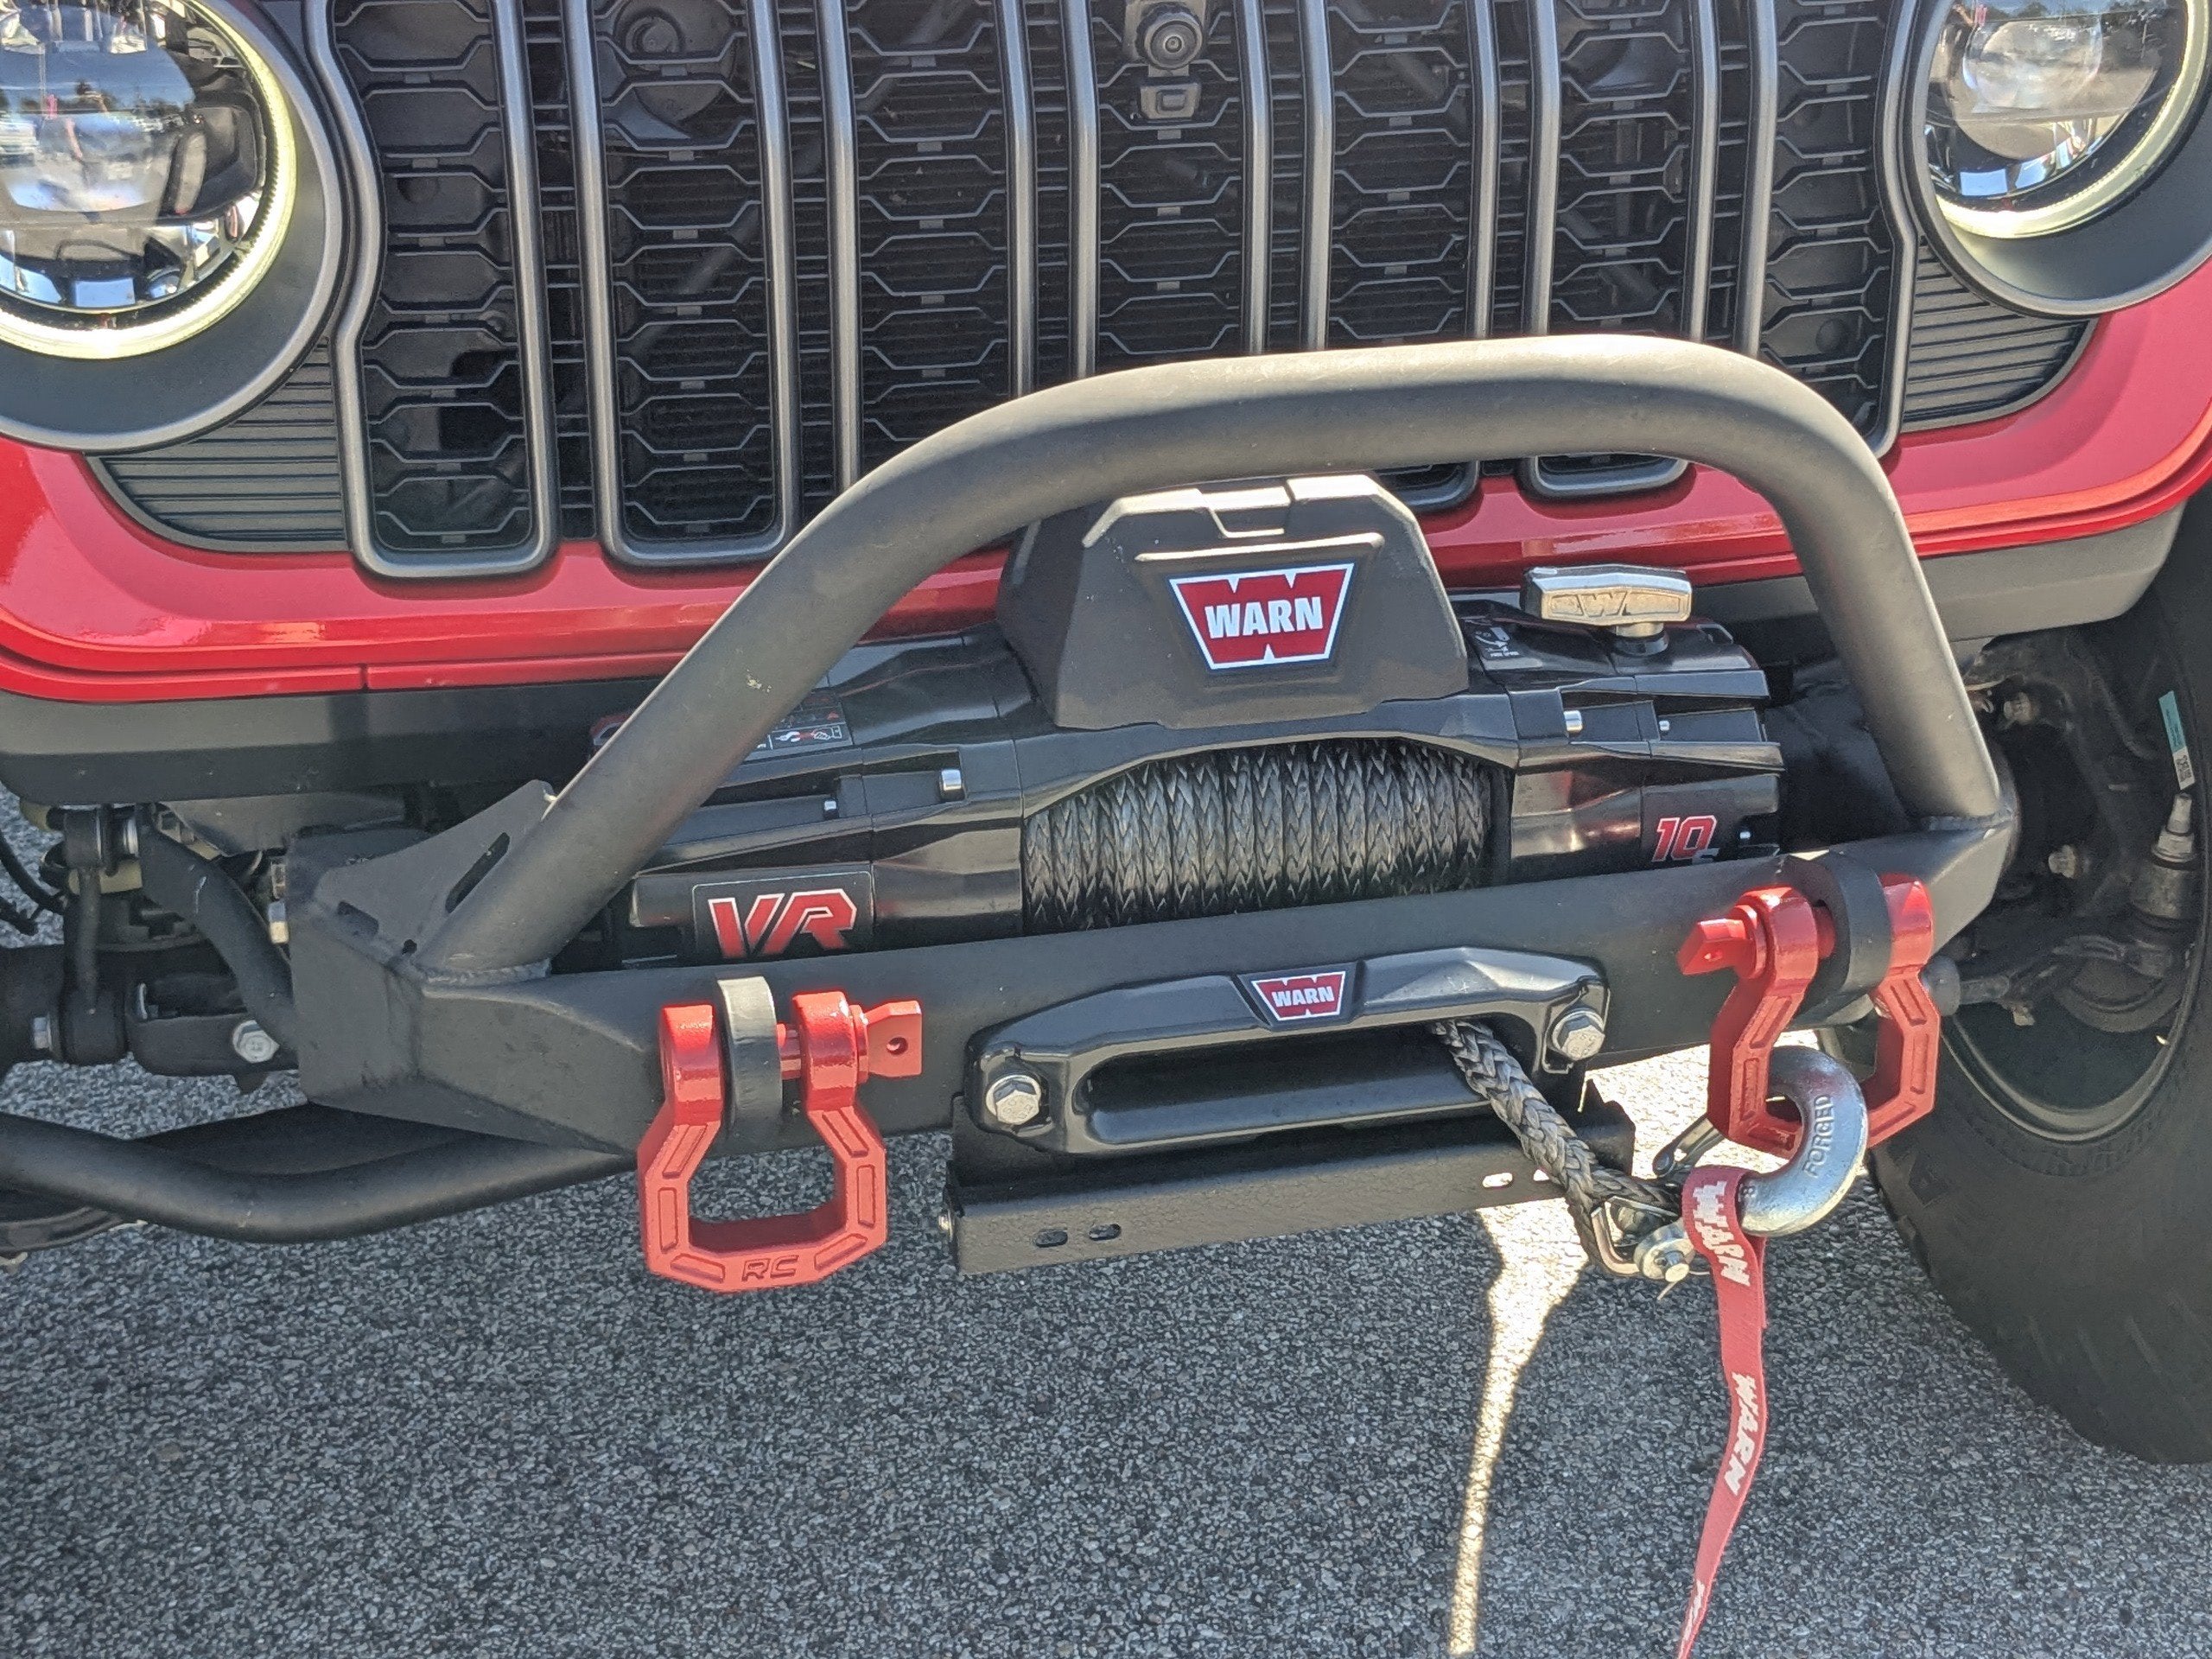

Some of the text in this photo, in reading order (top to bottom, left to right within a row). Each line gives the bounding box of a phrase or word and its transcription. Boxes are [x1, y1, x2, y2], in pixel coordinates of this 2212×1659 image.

[1204, 596, 1324, 639] WARN
[707, 887, 858, 959] VR
[1271, 985, 1335, 1008] WARN
[1802, 1093, 1834, 1179] FORGED
[741, 1254, 800, 1282] RC
[1692, 1180, 1751, 1287] WARN
[1723, 1371, 1759, 1497] WARN
